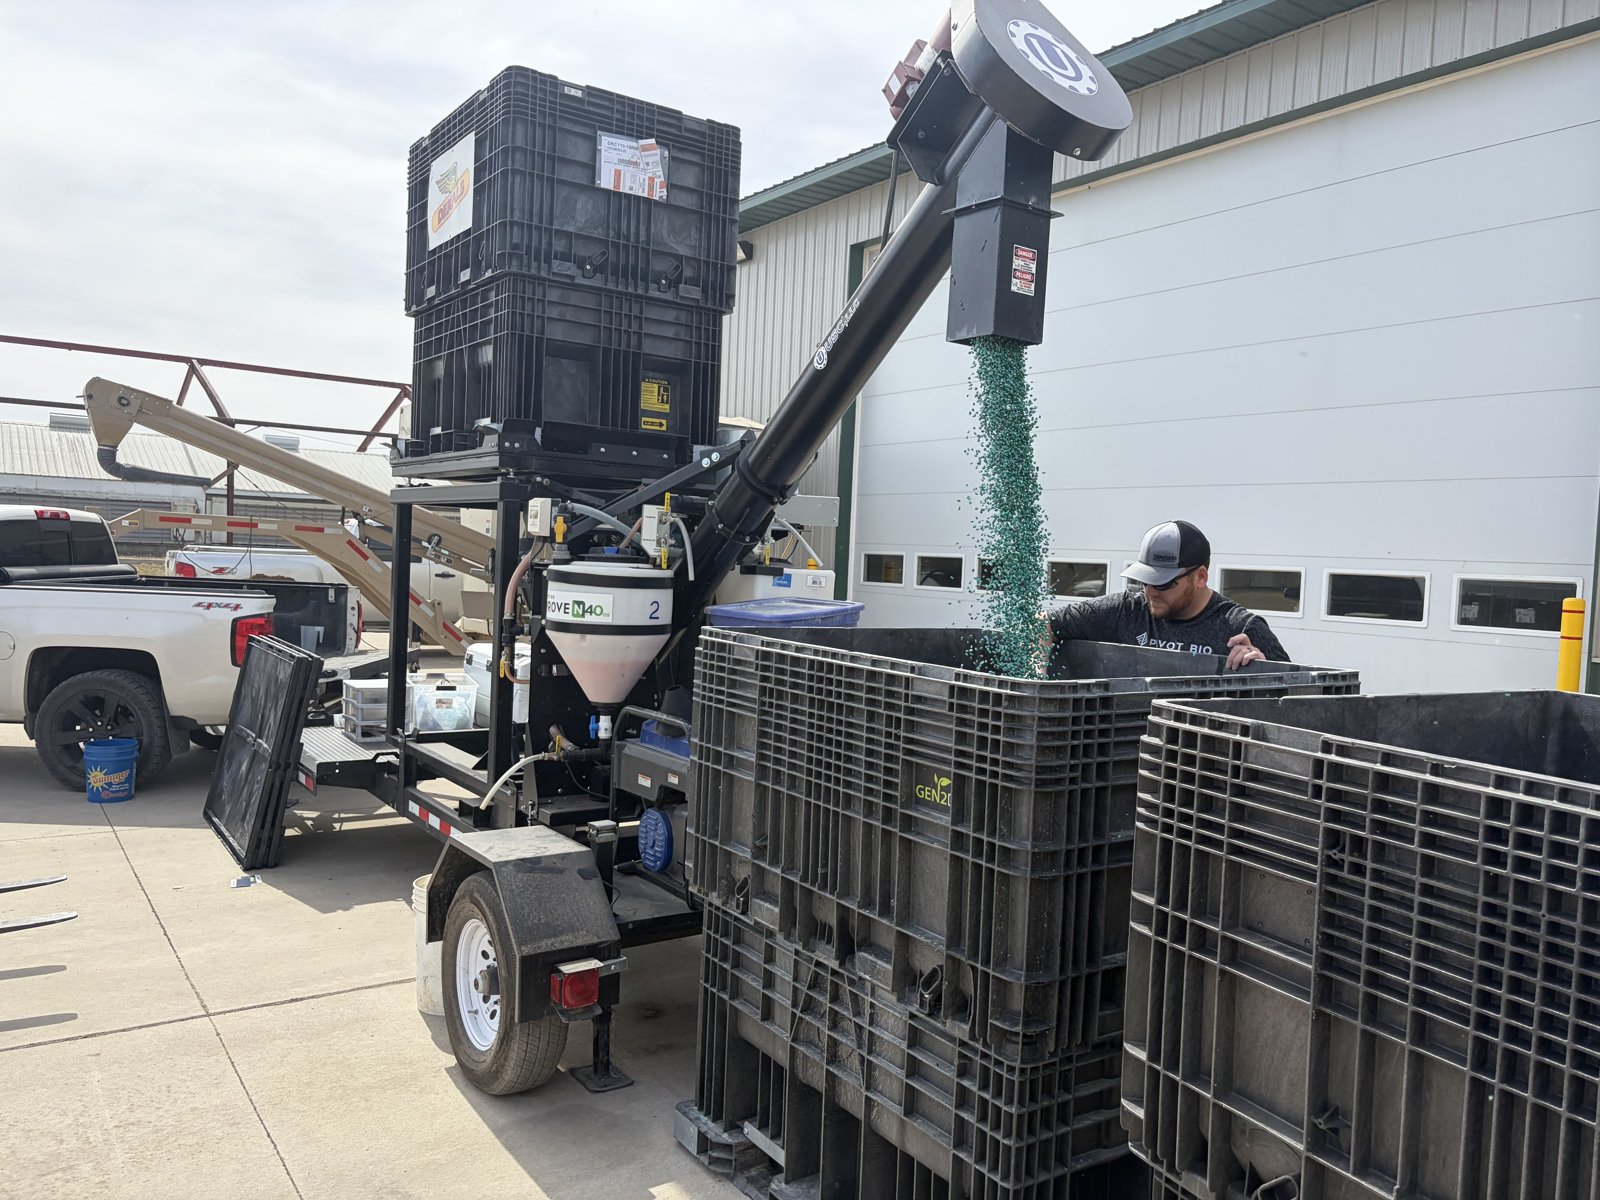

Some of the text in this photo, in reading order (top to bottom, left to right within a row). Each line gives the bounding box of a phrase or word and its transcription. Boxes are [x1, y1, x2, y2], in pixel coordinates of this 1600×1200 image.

[1017, 249, 1034, 259] DANGER
[1015, 271, 1033, 282] PELIGRO
[648, 600, 660, 620] 2
[1189, 643, 1213, 655] BIO
